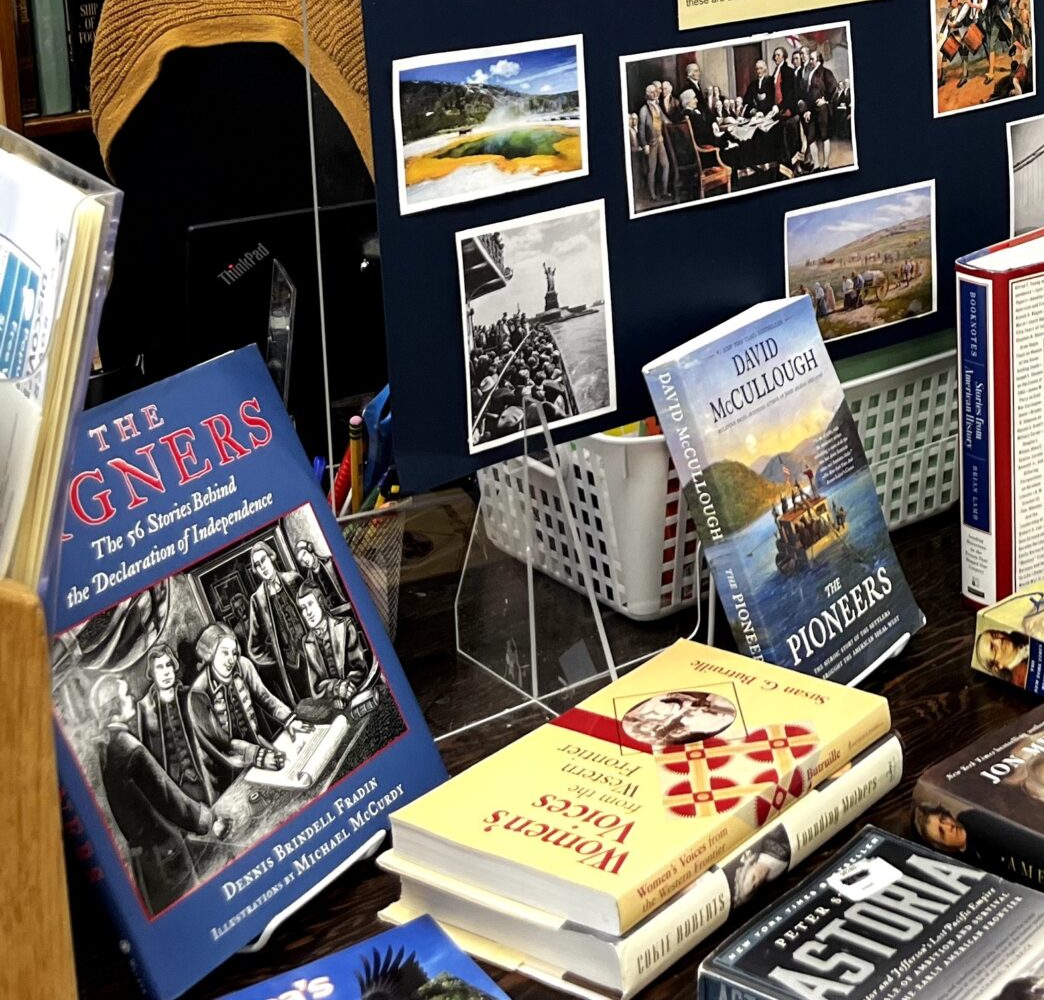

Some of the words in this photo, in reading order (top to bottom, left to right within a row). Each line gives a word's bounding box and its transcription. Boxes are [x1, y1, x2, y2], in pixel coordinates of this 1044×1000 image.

[217, 242, 270, 285] ThinkPad
[732, 337, 779, 377] DAVID
[709, 349, 819, 424] McCULLOUGH
[89, 404, 165, 451] THE
[64, 397, 273, 530] GNERS
[91, 535, 124, 560] The
[127, 523, 145, 546] 56
[147, 502, 192, 533] Stories
[191, 475, 237, 512] Behind
[67, 585, 90, 609] the
[92, 545, 176, 594] Declaration
[177, 529, 192, 555] of
[192, 491, 273, 545] Independence
[824, 577, 841, 598] THE
[786, 566, 893, 667] PIONEERS
[689, 660, 756, 688] Butruille
[783, 686, 831, 707] Susan
[556, 744, 642, 777] Frontier
[561, 763, 640, 800] Western
[980, 754, 1025, 784] JON
[567, 784, 601, 802] the
[608, 793, 643, 814] from
[222, 858, 275, 901] DENNIS
[272, 813, 335, 862] BRINDELL
[333, 777, 379, 816] FRADIN
[532, 794, 636, 845] Voices
[483, 809, 630, 876] Women's
[637, 937, 670, 976] COKIE
[676, 894, 726, 945] ROBERTS
[767, 853, 988, 1000] ASTORIA
[775, 906, 831, 949] PETER
